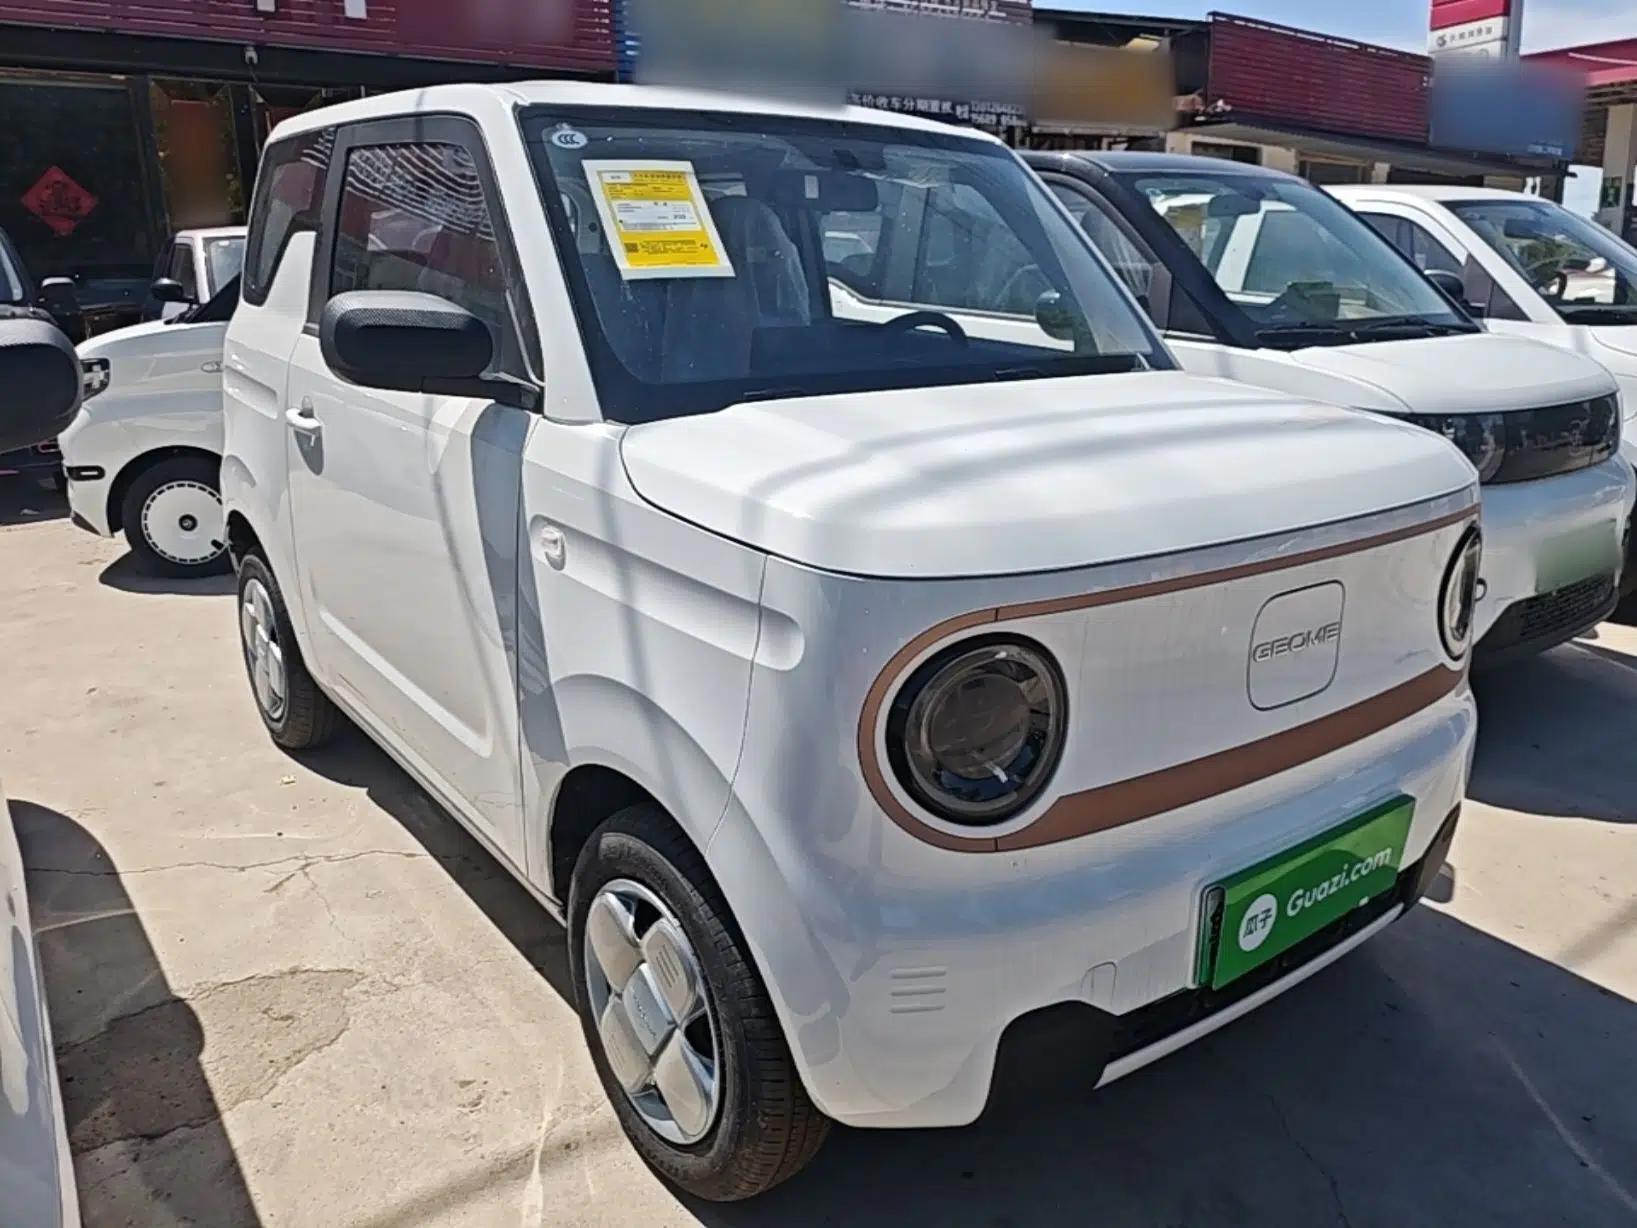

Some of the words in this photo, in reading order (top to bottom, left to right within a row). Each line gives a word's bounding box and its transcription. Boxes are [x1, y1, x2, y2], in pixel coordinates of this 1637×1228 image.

[1252, 621, 1341, 664] GEOME
[1286, 846, 1393, 918] Guazi.com
[1242, 907, 1273, 938] 瓜子
